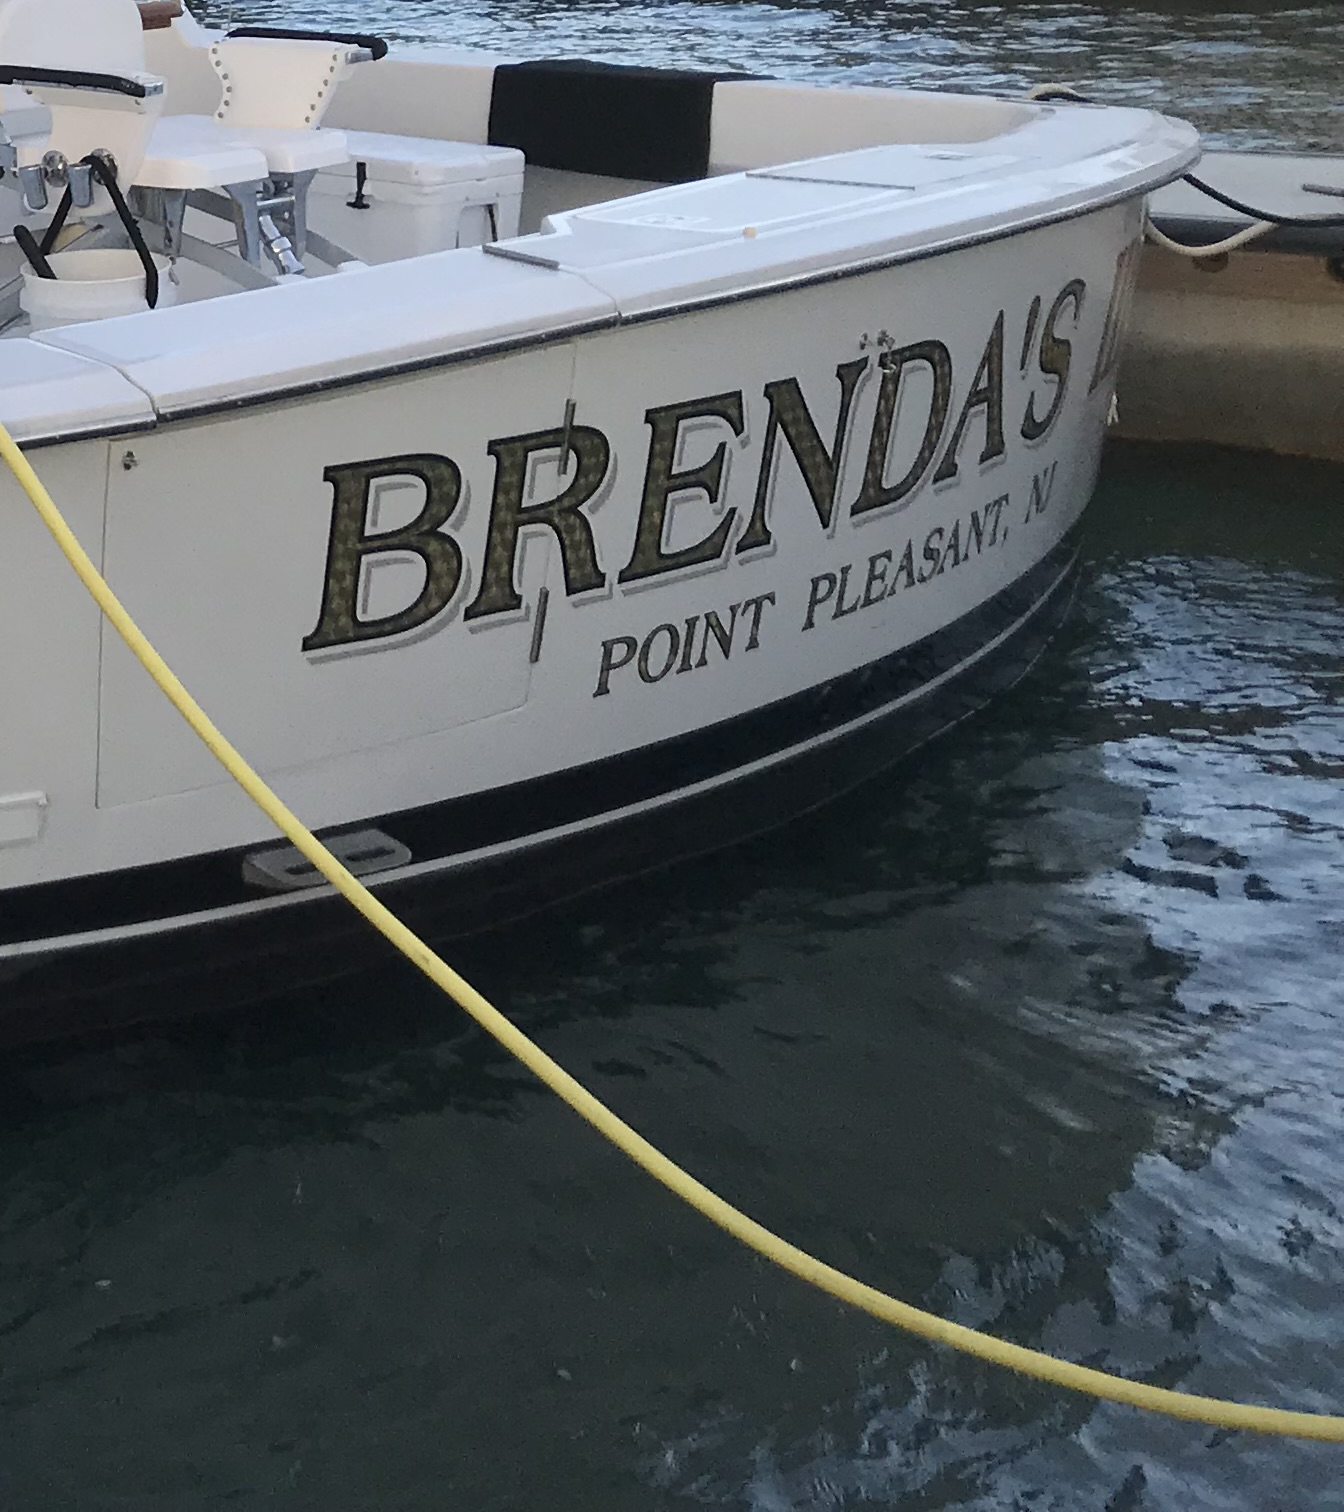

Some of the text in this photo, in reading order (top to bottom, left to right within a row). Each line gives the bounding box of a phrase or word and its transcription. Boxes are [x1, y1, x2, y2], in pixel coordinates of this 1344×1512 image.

[301, 277, 1087, 656] BRENDA'S
[592, 459, 1059, 698] POINT PLEASANT, NJ
